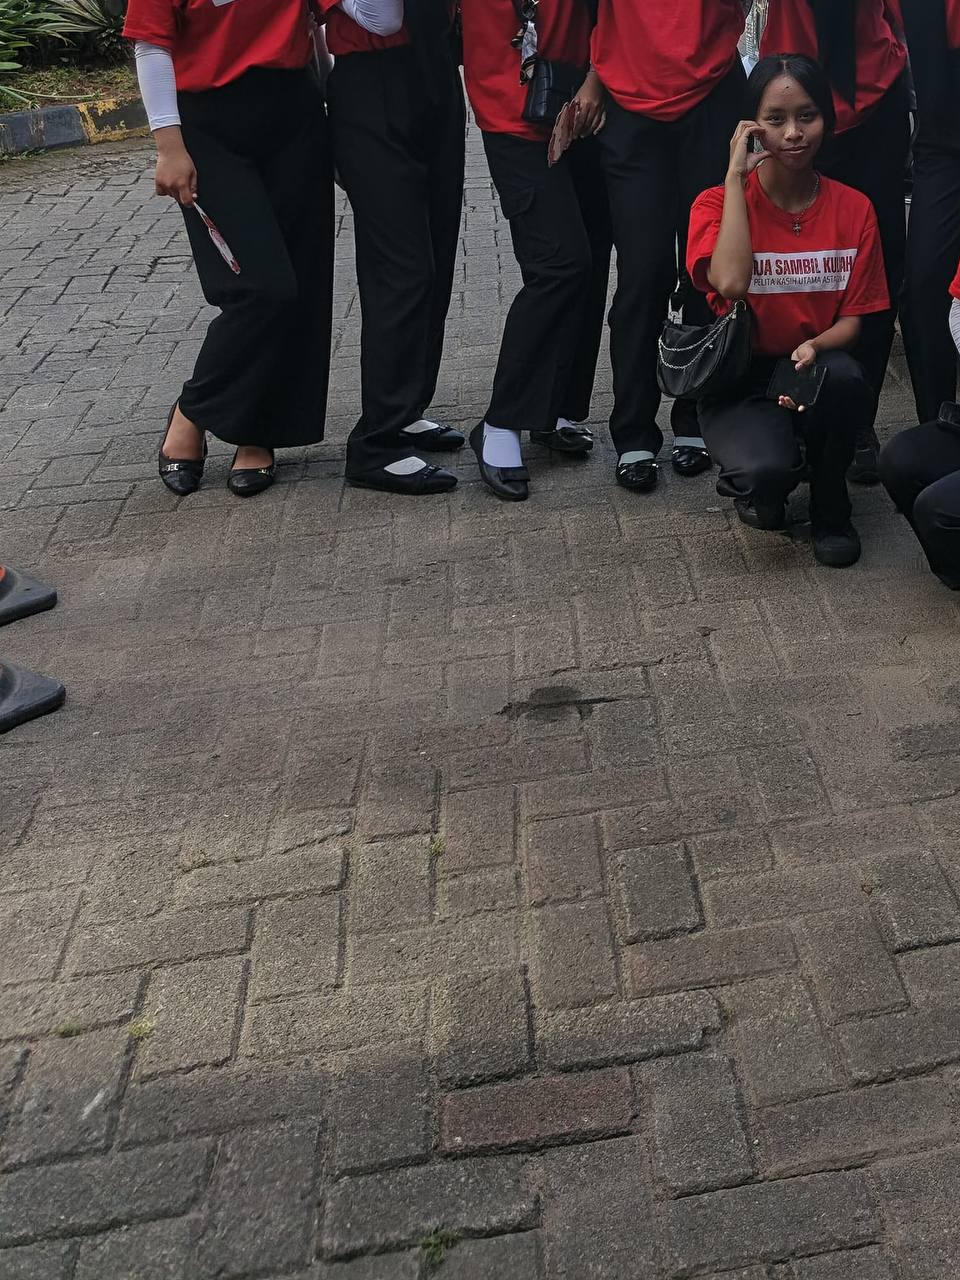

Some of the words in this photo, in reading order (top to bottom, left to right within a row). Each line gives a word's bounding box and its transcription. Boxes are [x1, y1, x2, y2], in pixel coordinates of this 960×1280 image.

[753, 259, 773, 276] RJA
[775, 257, 821, 276] SAMBIL
[753, 278, 776, 287] PELITA
